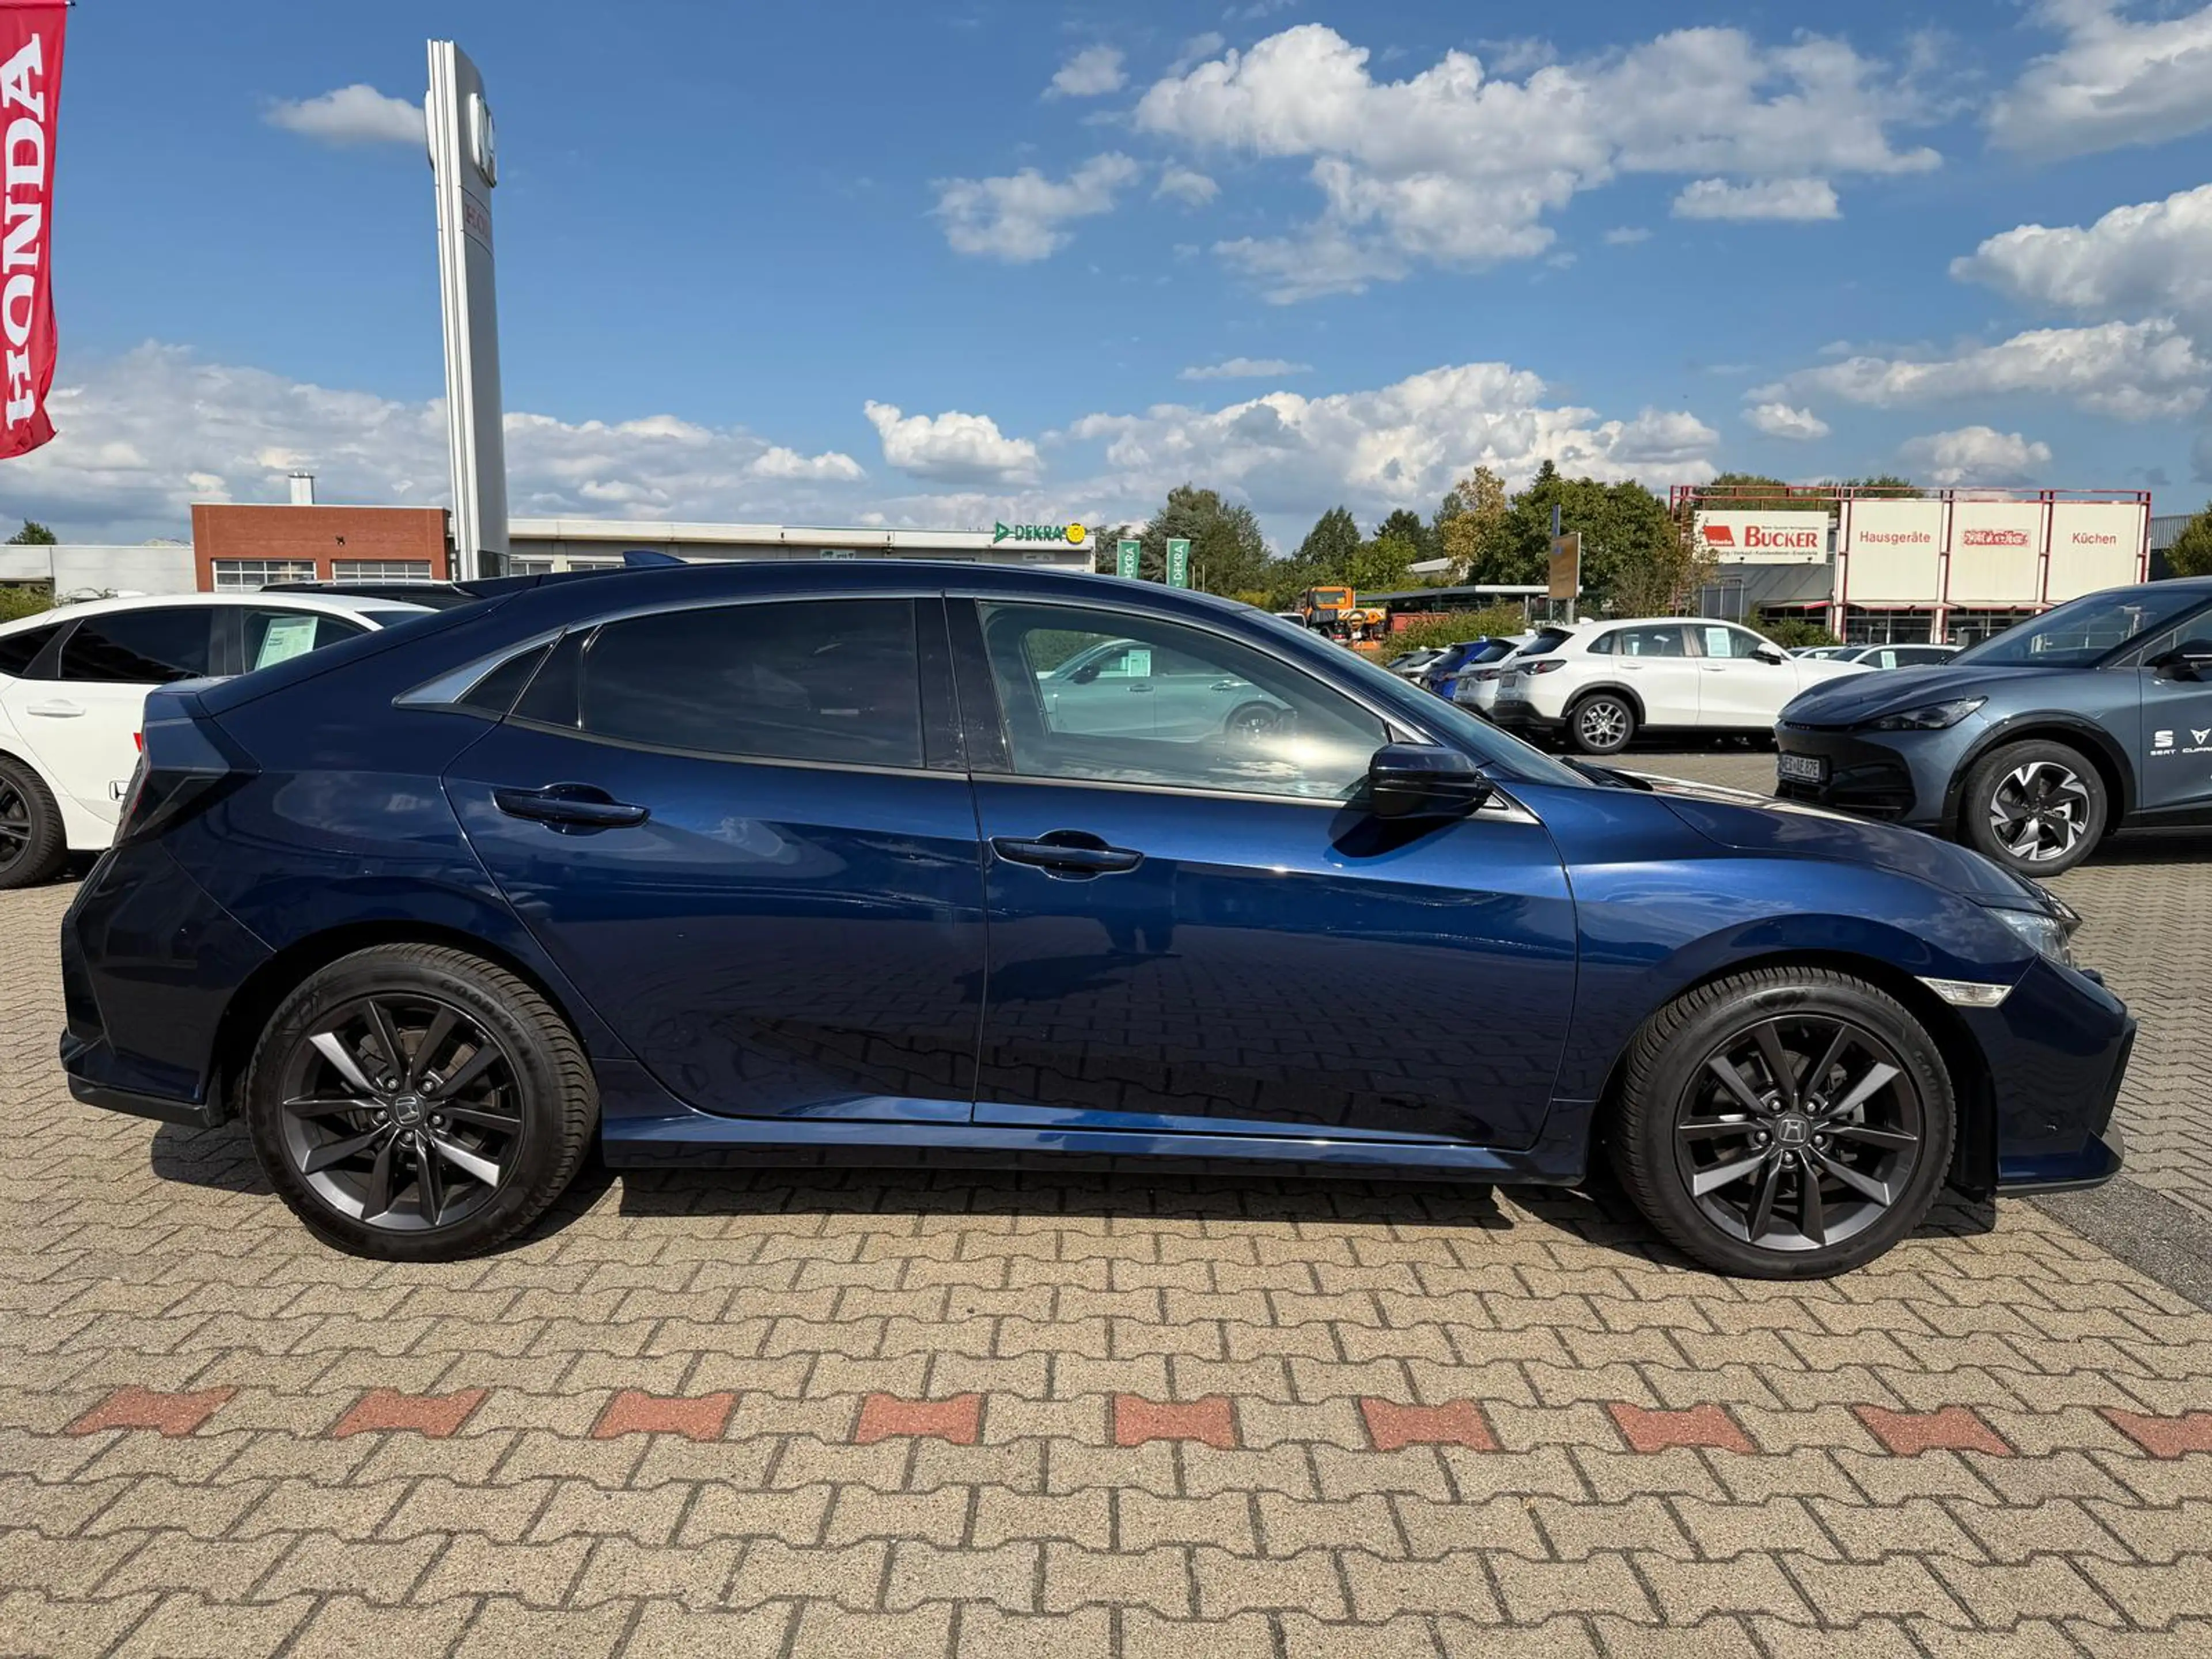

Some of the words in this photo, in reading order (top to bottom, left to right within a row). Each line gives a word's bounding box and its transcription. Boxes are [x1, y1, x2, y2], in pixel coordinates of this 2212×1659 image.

[0, 33, 44, 430] HONDA
[1014, 525, 1063, 541] DEKRA
[1859, 531, 1931, 545] Hausgeräte
[2072, 532, 2116, 544] Küchen
[1173, 544, 1184, 581] DEKRA
